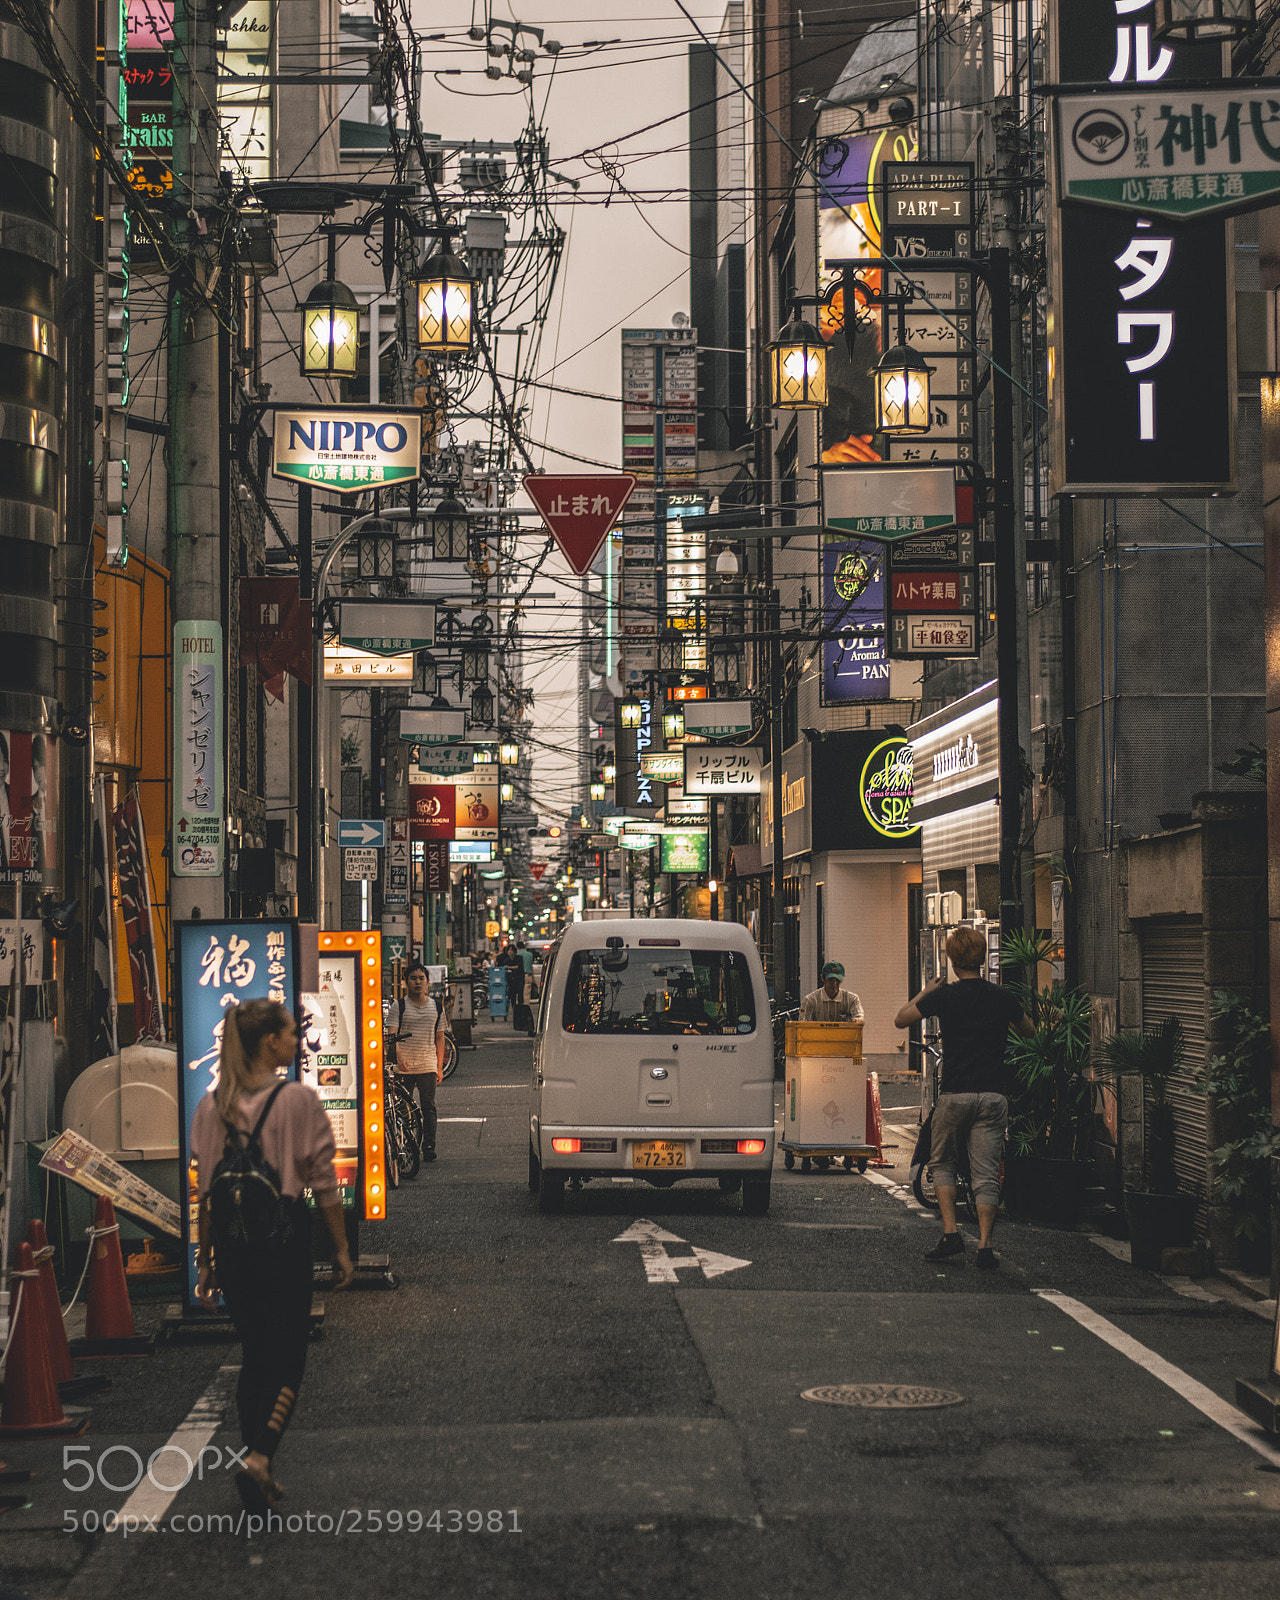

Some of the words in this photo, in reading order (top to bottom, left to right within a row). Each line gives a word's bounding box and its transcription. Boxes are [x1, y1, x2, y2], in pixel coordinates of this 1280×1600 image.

[141, 113, 166, 123] BAR
[1122, 174, 1245, 203] 心斎橋東通
[897, 201, 962, 217] PART-I
[288, 420, 408, 452] NIPPO
[308, 465, 385, 482] 心斎橋東通
[547, 494, 613, 517] 止まれ
[669, 494, 704, 505] フェアリー
[856, 516, 925, 532] 心斎橋東通
[896, 581, 956, 600] ハトヤ薬局
[181, 637, 215, 654] HOTEL
[362, 638, 412, 650] 心斎橋東通
[915, 630, 969, 646] 平和食堂
[850, 650, 880, 661] Aroma
[699, 755, 750, 769] リップル
[695, 770, 755, 785] 千扇ビル
[644, 1152, 684, 1167] 72-32
